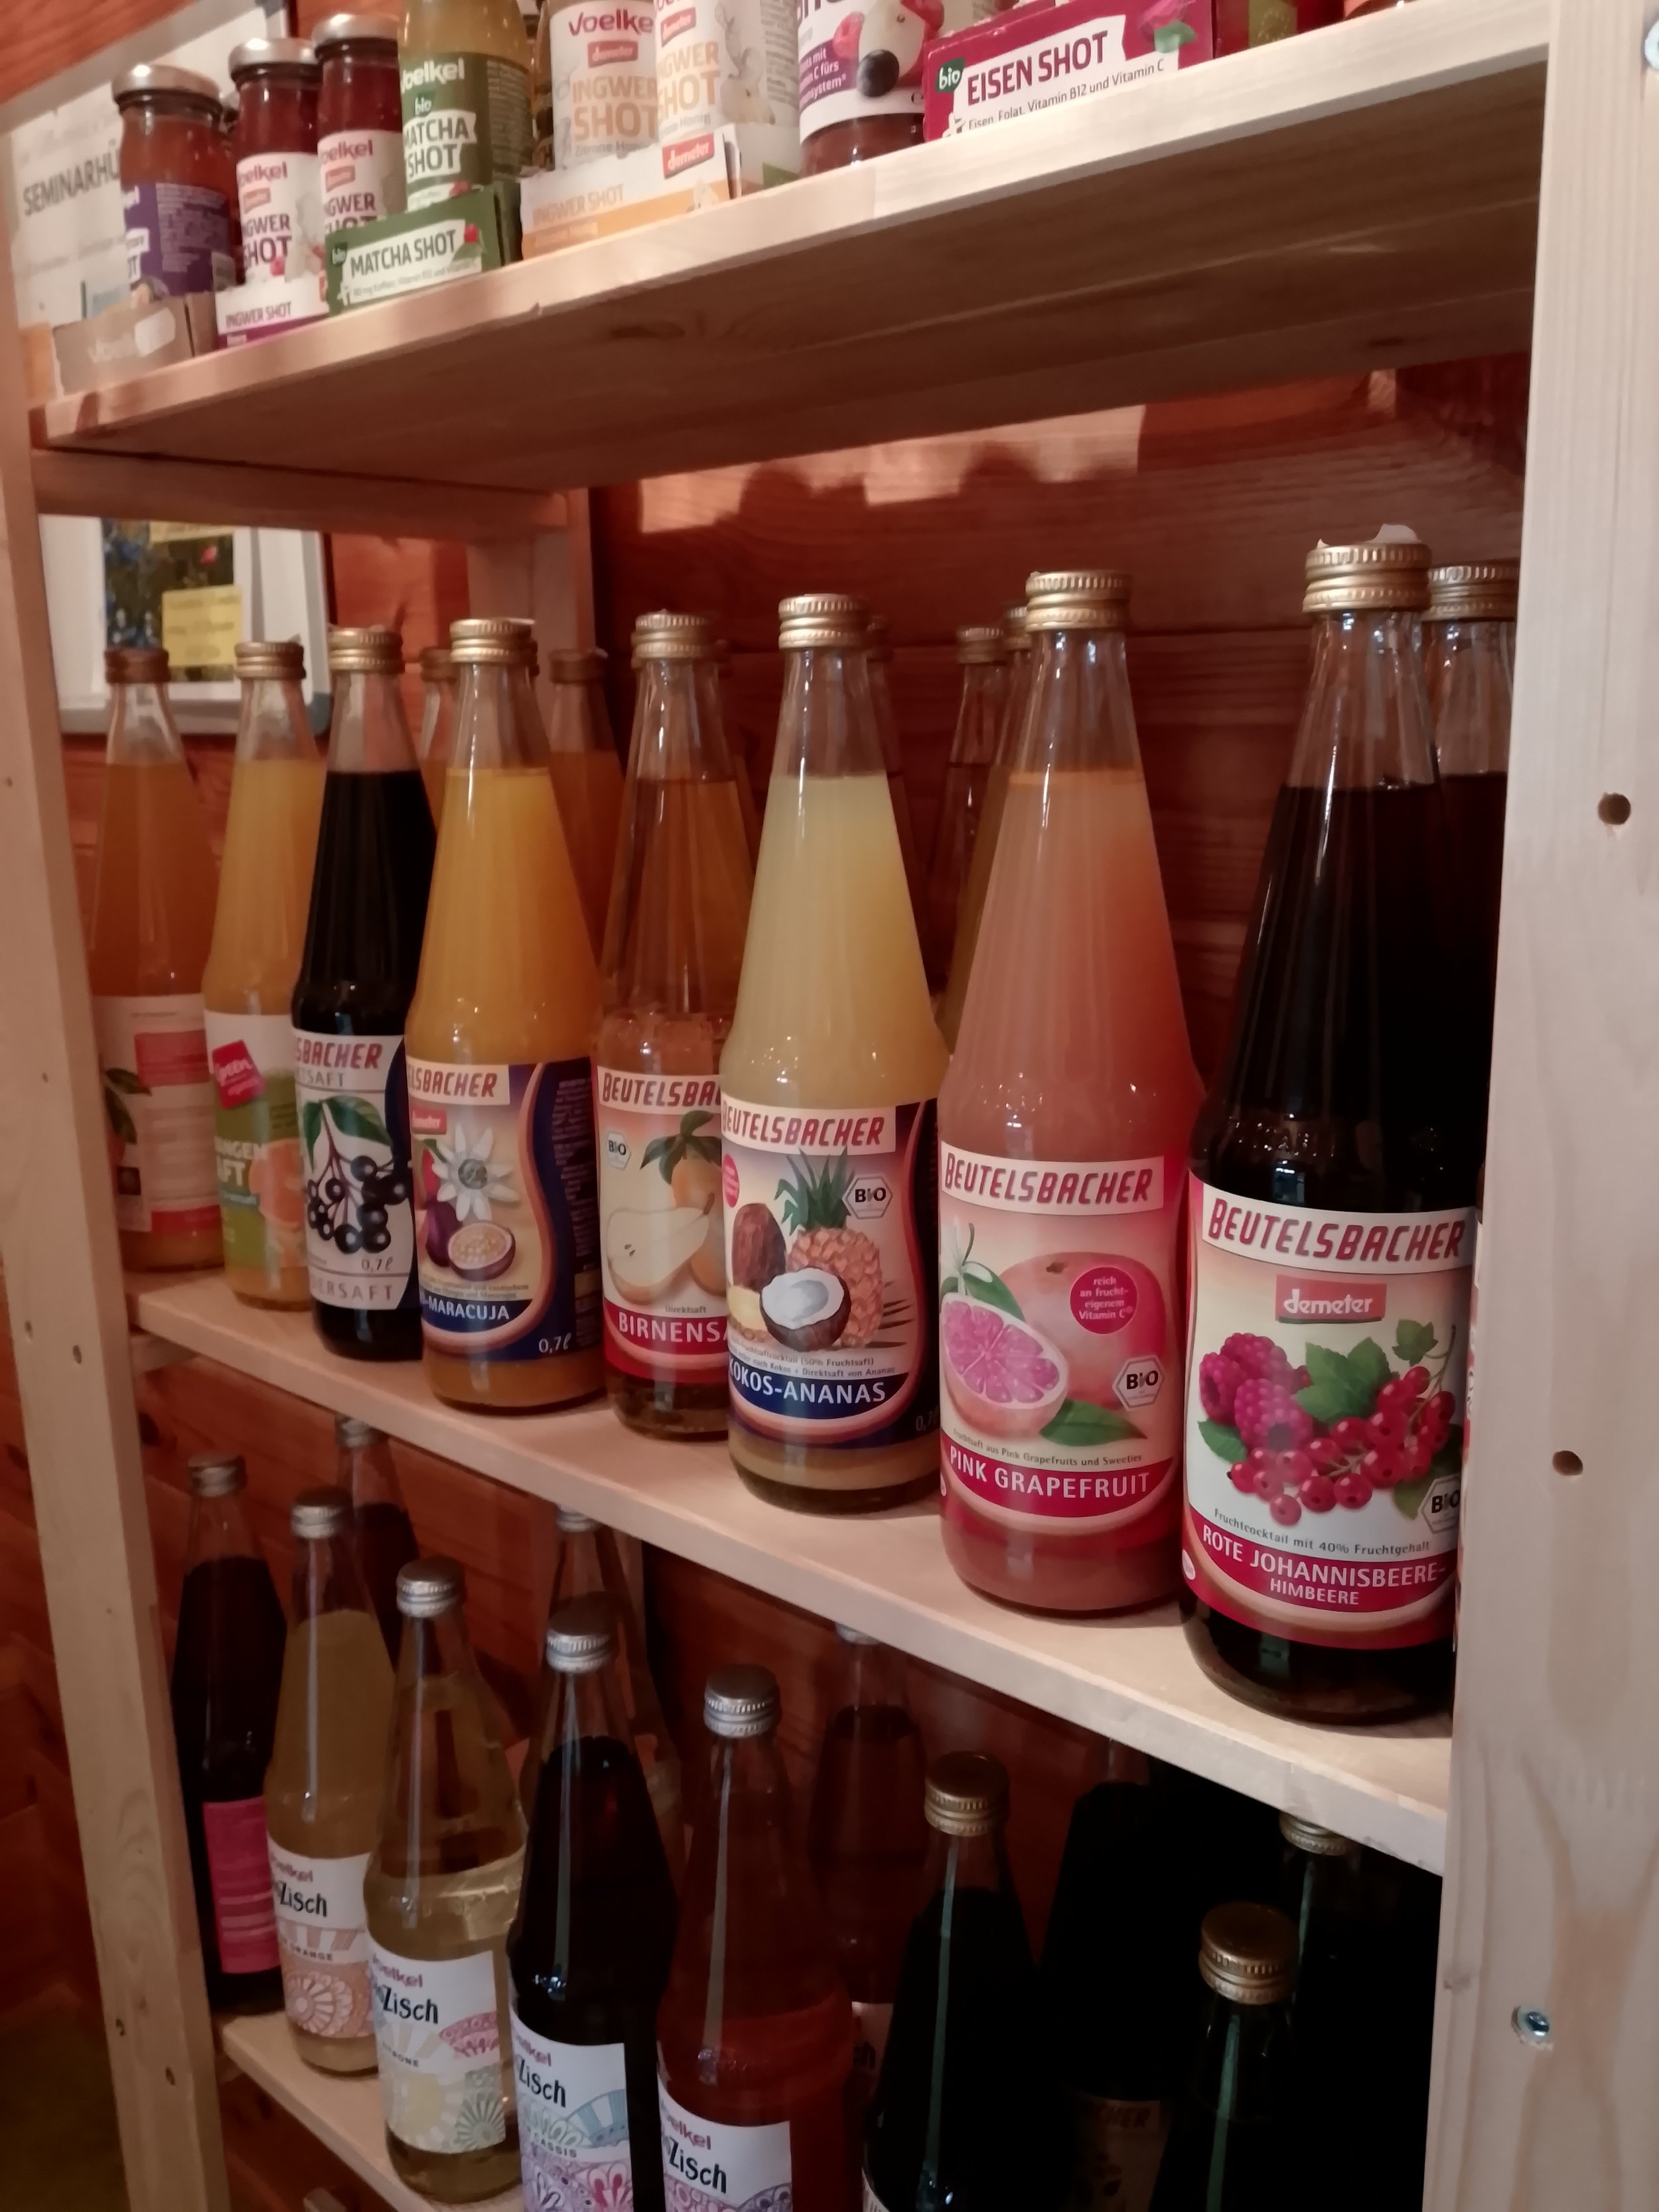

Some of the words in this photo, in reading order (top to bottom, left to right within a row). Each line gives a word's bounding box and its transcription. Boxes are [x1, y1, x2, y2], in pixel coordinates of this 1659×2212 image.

[939, 67, 961, 90] bio
[968, 56, 1033, 106] EISEN
[1039, 30, 1108, 82] SHOT
[1028, 91, 1068, 113] Vitamin
[1070, 83, 1087, 102] B12
[1089, 76, 1110, 94] und
[1112, 64, 1155, 86] Vitamin
[1157, 58, 1165, 72] C
[573, 102, 660, 142] SHOT
[407, 143, 457, 178] SHOT
[350, 242, 412, 278] MATCHA
[414, 228, 457, 263] SHOT
[944, 1152, 1153, 1205] BEUTELSBACHER
[1208, 1197, 1465, 1262] BEUTELSBACHER
[1093, 1276, 1117, 1286] reich
[1078, 1309, 1117, 1320] Vitamin
[1084, 1299, 1125, 1311] eigenem
[1283, 1288, 1373, 1314] demeter
[618, 1311, 727, 1343] BIRNENS
[802, 1367, 844, 1377] Direktsaft
[865, 1366, 895, 1376] Ananas
[827, 1357, 875, 1366] Fruchtsaft)
[950, 1444, 987, 1483] PINK
[994, 1467, 1150, 1499] GRAPEFRUIT
[986, 1445, 999, 1455] aus
[1001, 1447, 1020, 1459] Pink
[1023, 1451, 1078, 1466] Grapefruits
[1081, 1456, 1099, 1466] und
[1102, 1454, 1142, 1465] Sweeties
[1214, 1507, 1289, 1544] Fruchtcocktail
[1293, 1538, 1314, 1550] mit
[1318, 1541, 1350, 1554] 40%
[1354, 1540, 1429, 1557] Fruchtgehalt
[1202, 1524, 1244, 1562] ROTE
[1249, 1549, 1447, 1588] JOHANNISBEERE-
[1269, 1578, 1360, 1606] HIMBEERE
